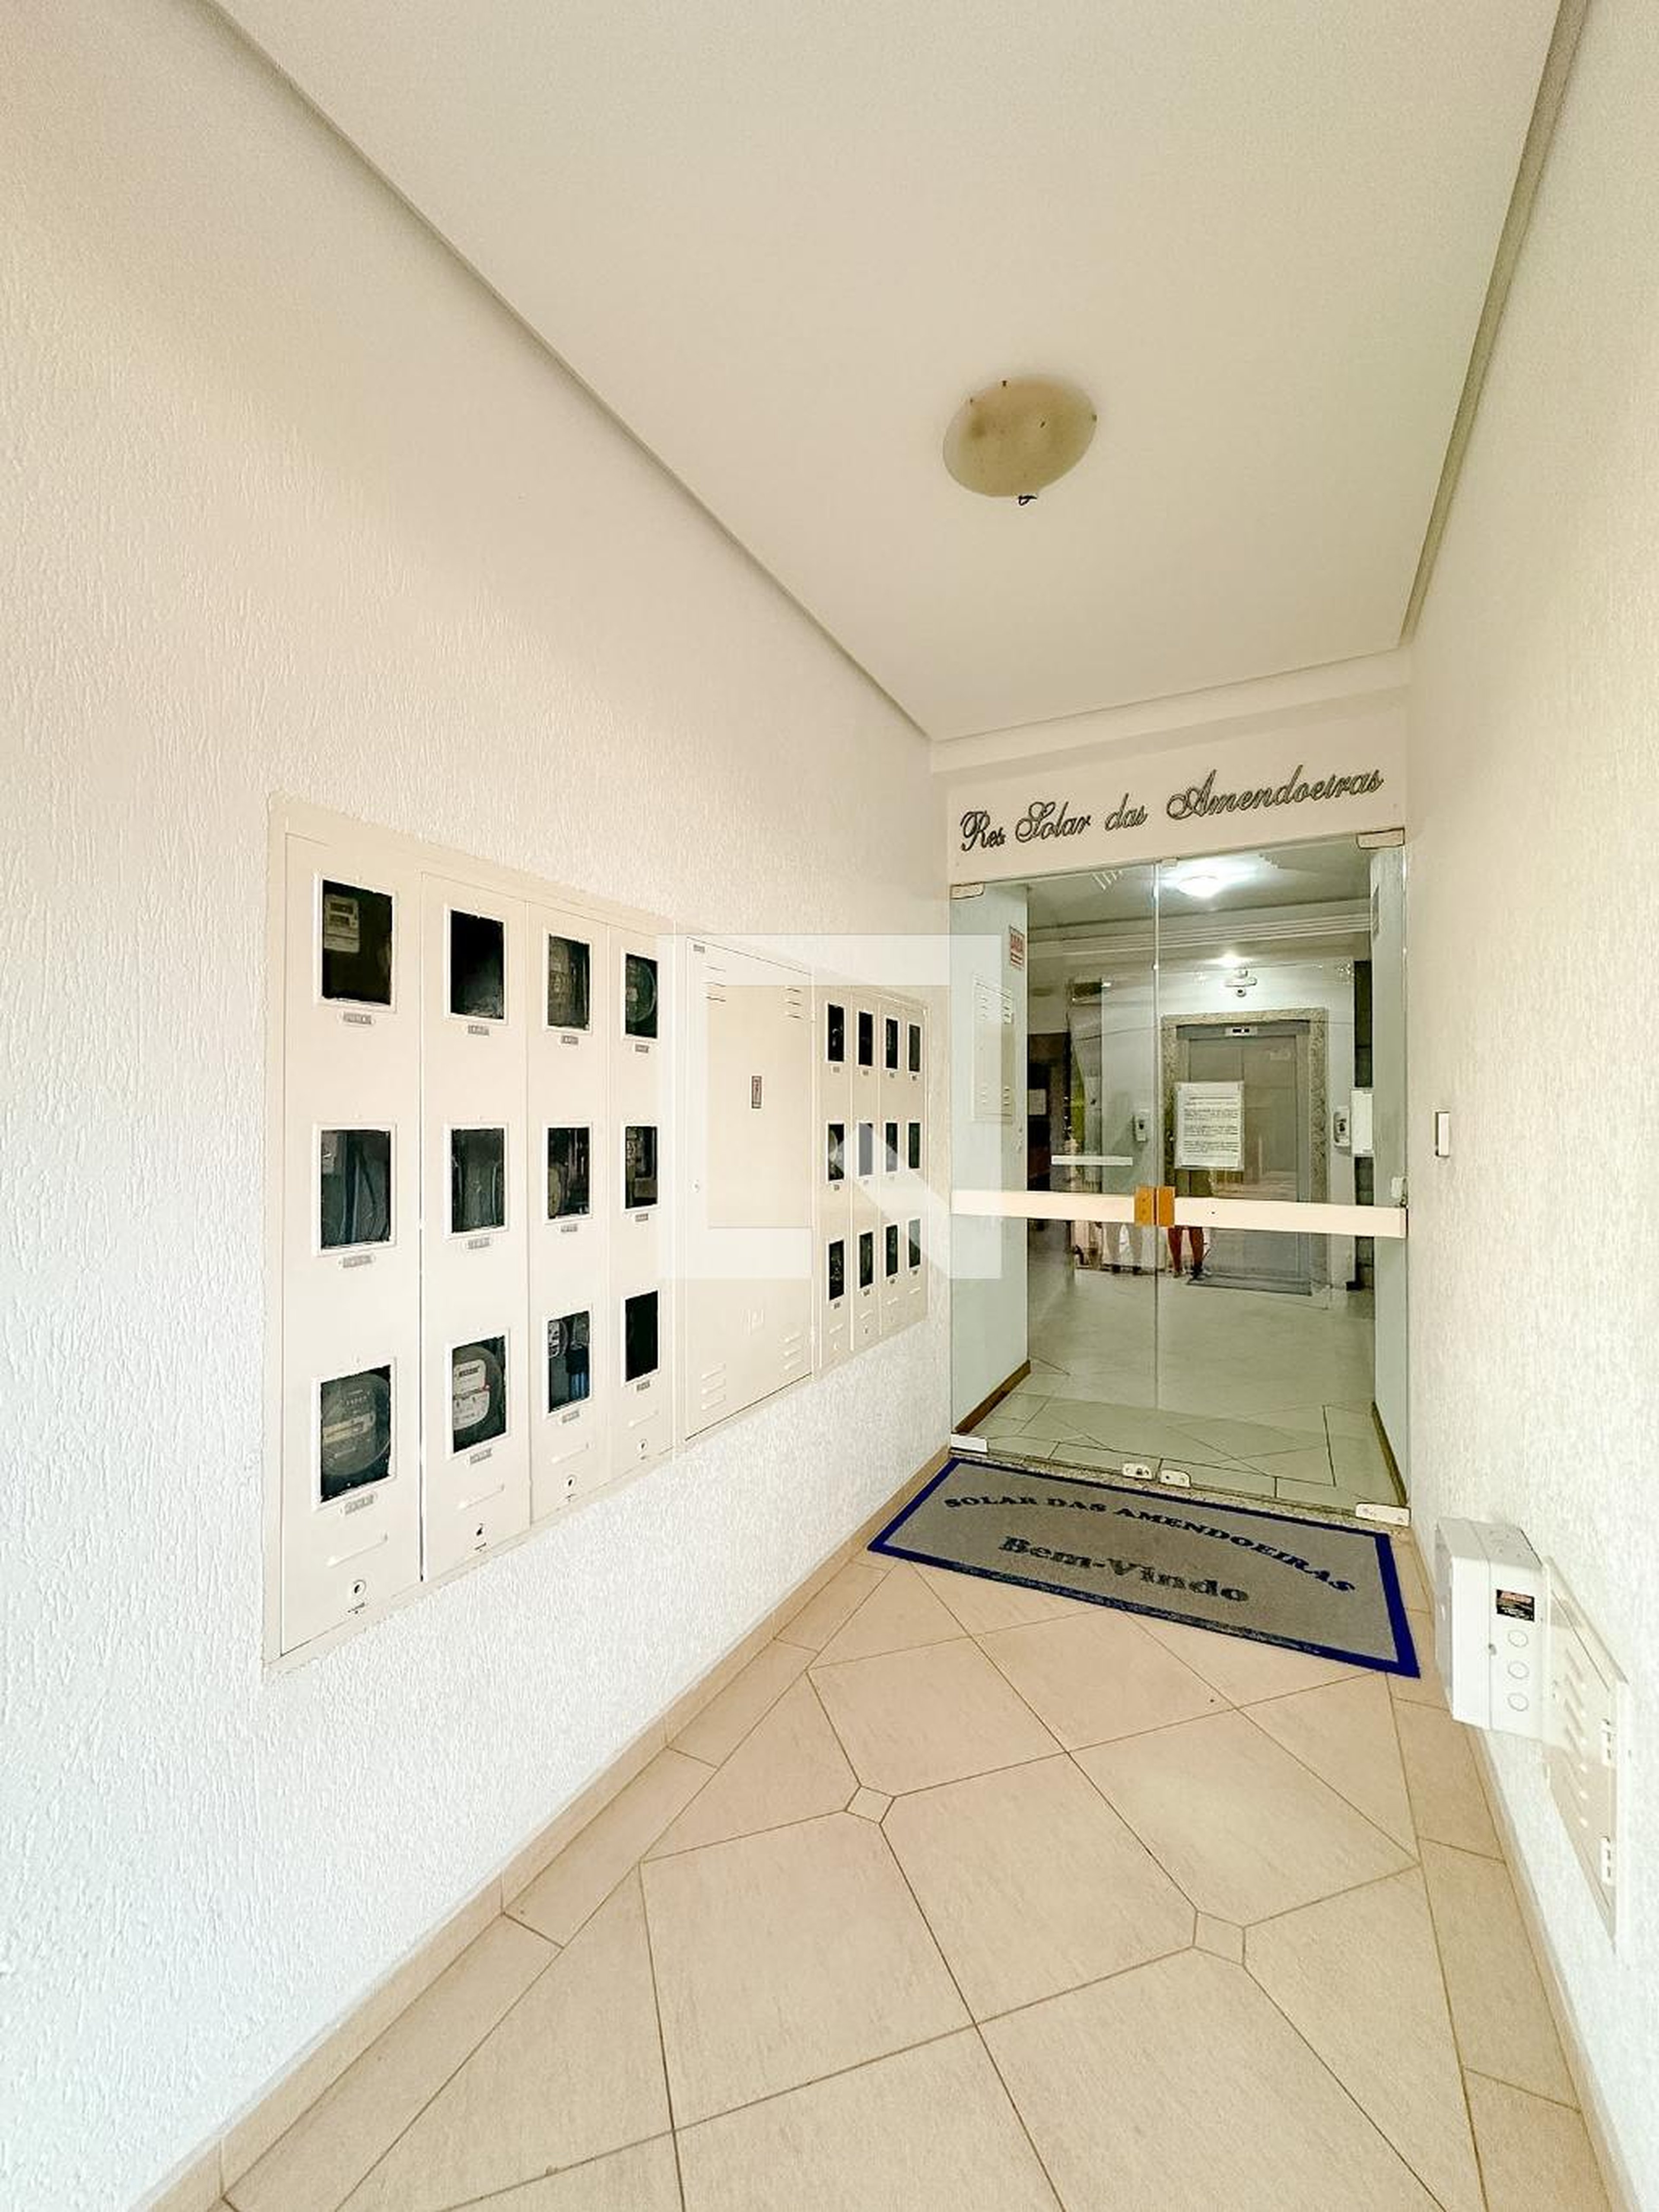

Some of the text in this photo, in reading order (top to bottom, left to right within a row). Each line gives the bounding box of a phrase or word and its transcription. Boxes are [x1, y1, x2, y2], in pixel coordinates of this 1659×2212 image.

[960, 764, 1384, 851] Res Solar das Amendoeiras
[944, 1496, 1356, 1592] SOLAR DAS AMENDOEIRAS
[998, 1536, 1249, 1601] Bem-Vindo
